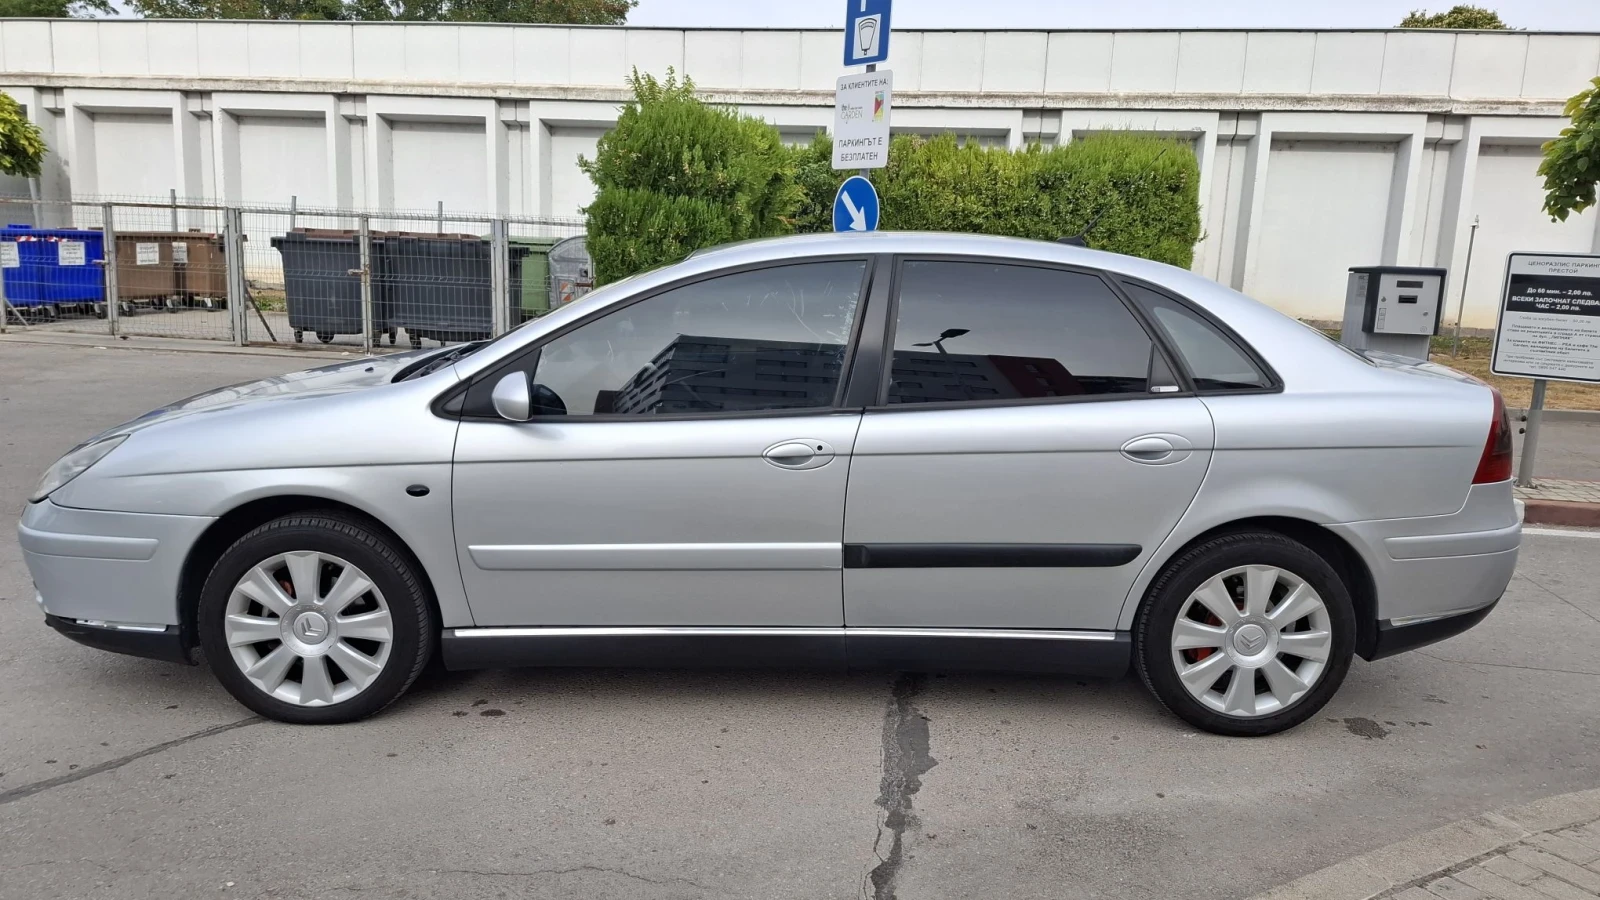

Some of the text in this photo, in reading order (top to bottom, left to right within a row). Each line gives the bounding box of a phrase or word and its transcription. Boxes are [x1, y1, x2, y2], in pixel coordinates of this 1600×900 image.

[848, 79, 878, 90] КЛИЕНТИТЕ
[838, 137, 877, 148] ПАРКИНГЪТ
[840, 152, 878, 162] БЕЗПЛАТЕН
[1528, 260, 1571, 268] ЦЕНОРАЗПИС
[1534, 296, 1571, 304] ЗАПОЧНАТ
[1572, 298, 1600, 306] СЛЕДВА
